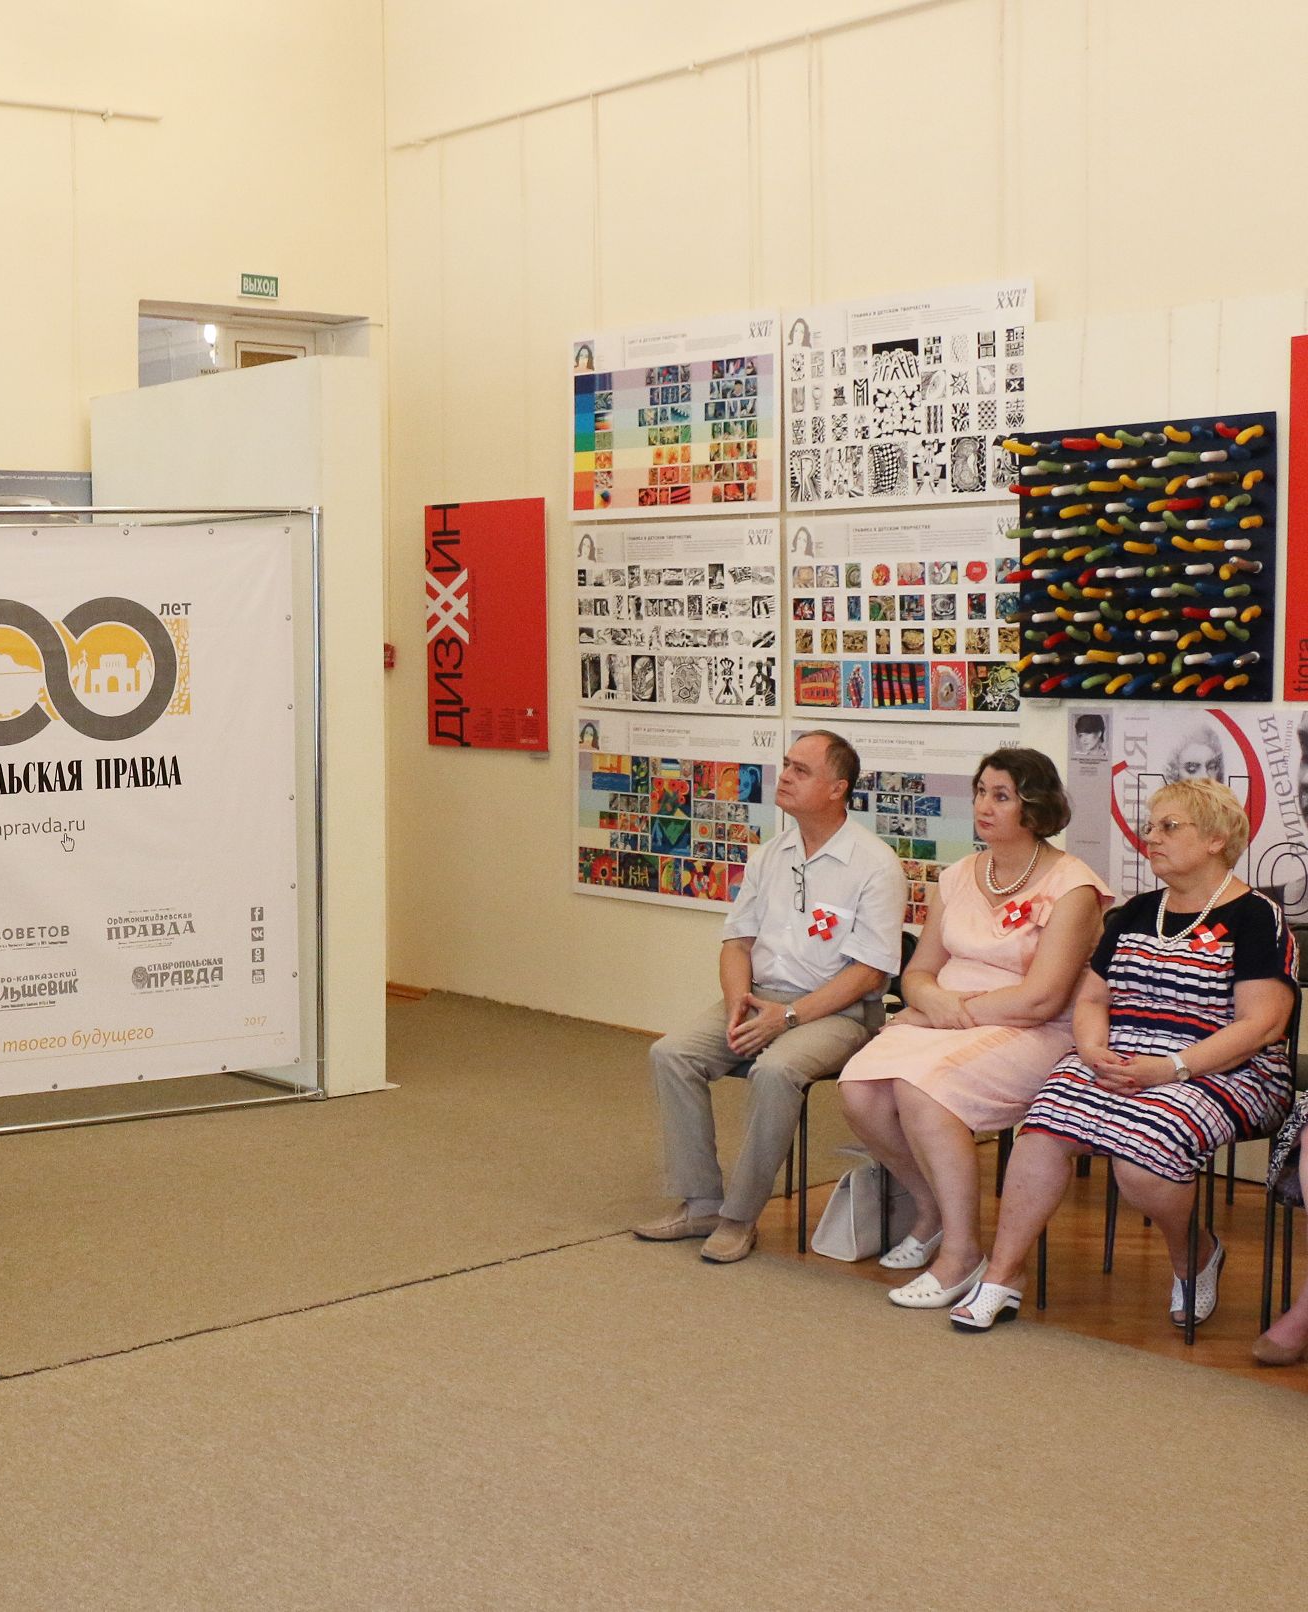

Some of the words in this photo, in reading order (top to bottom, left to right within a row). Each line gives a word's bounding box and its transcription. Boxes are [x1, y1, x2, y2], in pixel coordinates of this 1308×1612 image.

[243, 277, 277, 296] ВЫХОД
[996, 296, 1021, 310] XXI
[159, 601, 192, 616] лет
[95, 754, 182, 791] ПРАВДА
[106, 920, 196, 941] ПРАВДА
[147, 957, 224, 973] СТАВРОПОЛЬСКАЯ
[147, 966, 224, 989] ПРАВДА
[244, 1016, 268, 1027] 2017
[2, 1035, 67, 1054] твоего
[71, 1026, 154, 1049] будущего
